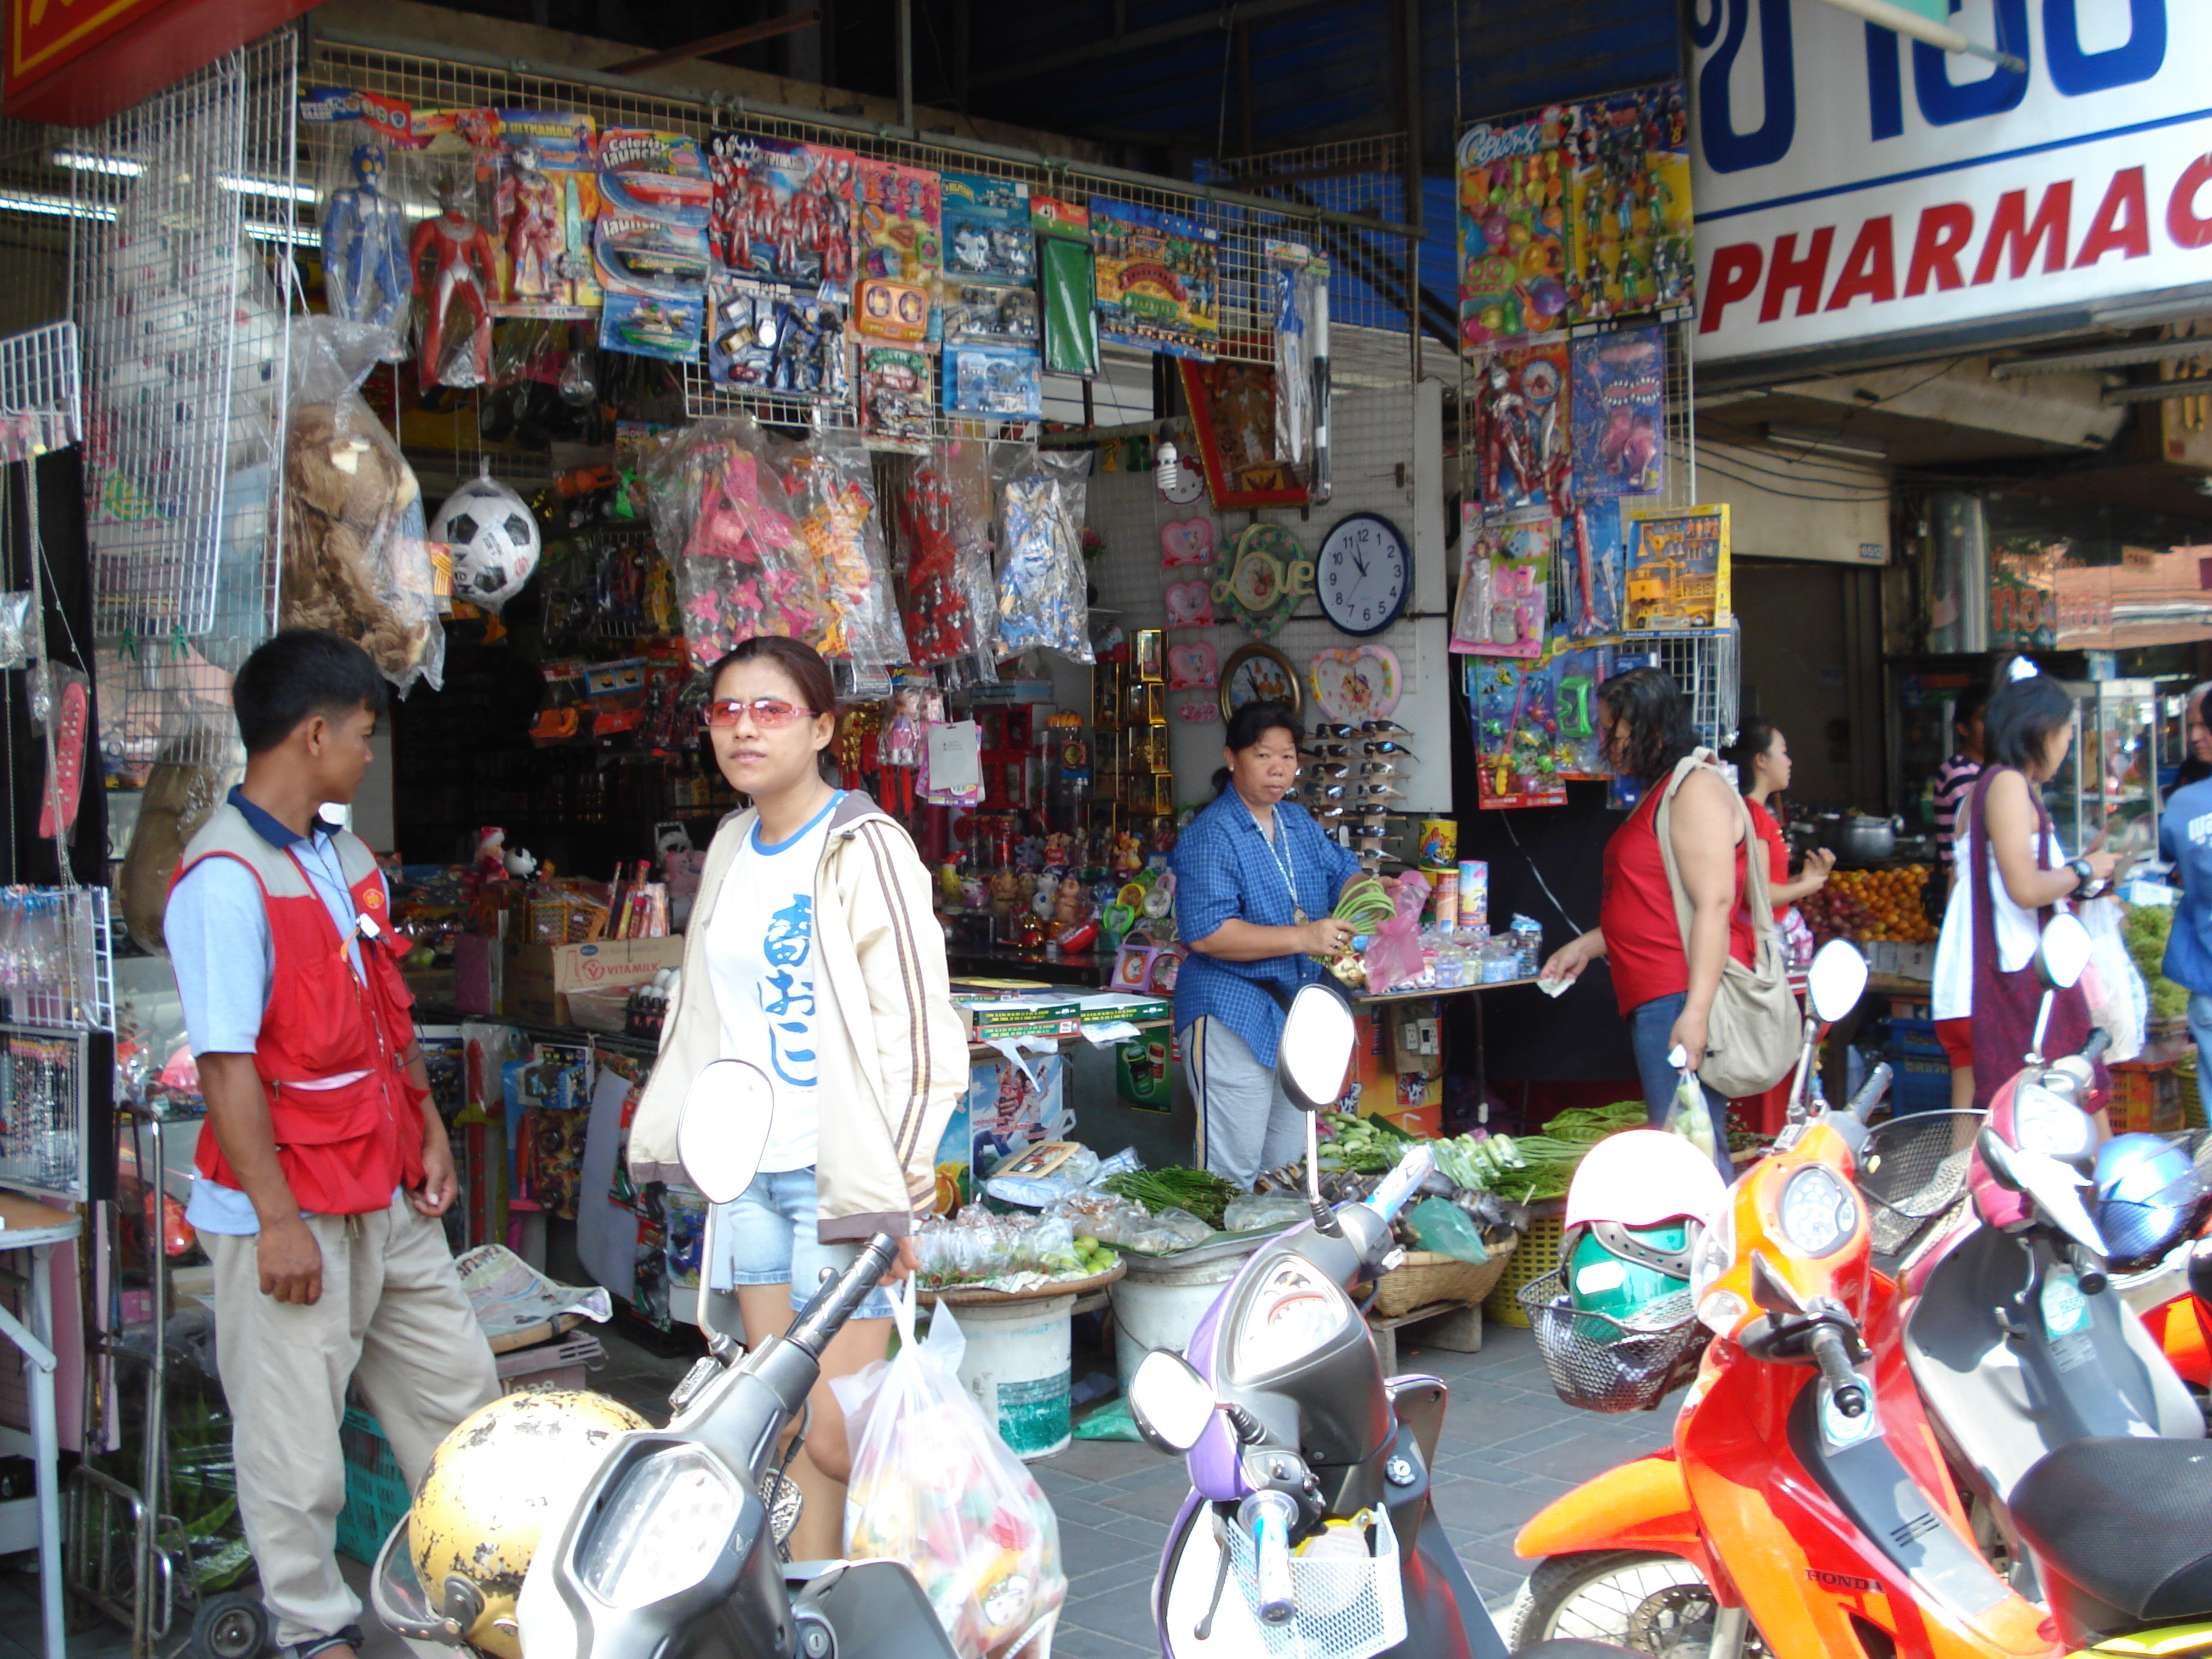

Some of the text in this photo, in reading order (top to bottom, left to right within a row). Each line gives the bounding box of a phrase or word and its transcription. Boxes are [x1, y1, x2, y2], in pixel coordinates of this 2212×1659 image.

[509, 122, 573, 138] ULTRAMAN
[1357, 529, 1370, 542] 12
[1376, 533, 1382, 546] 1
[1343, 536, 1354, 549] 11
[1387, 545, 1395, 558] 2
[1333, 552, 1344, 565] 10
[1394, 565, 1402, 577] 3
[1329, 572, 1337, 585] 9
[1389, 585, 1397, 598] 4
[1336, 592, 1344, 605] 8
[1348, 604, 1355, 617] 7
[1378, 601, 1387, 614] 5
[1363, 608, 1371, 621] 6
[607, 962, 660, 976] VITAMILK
[1806, 1570, 1884, 1592] HONDA
